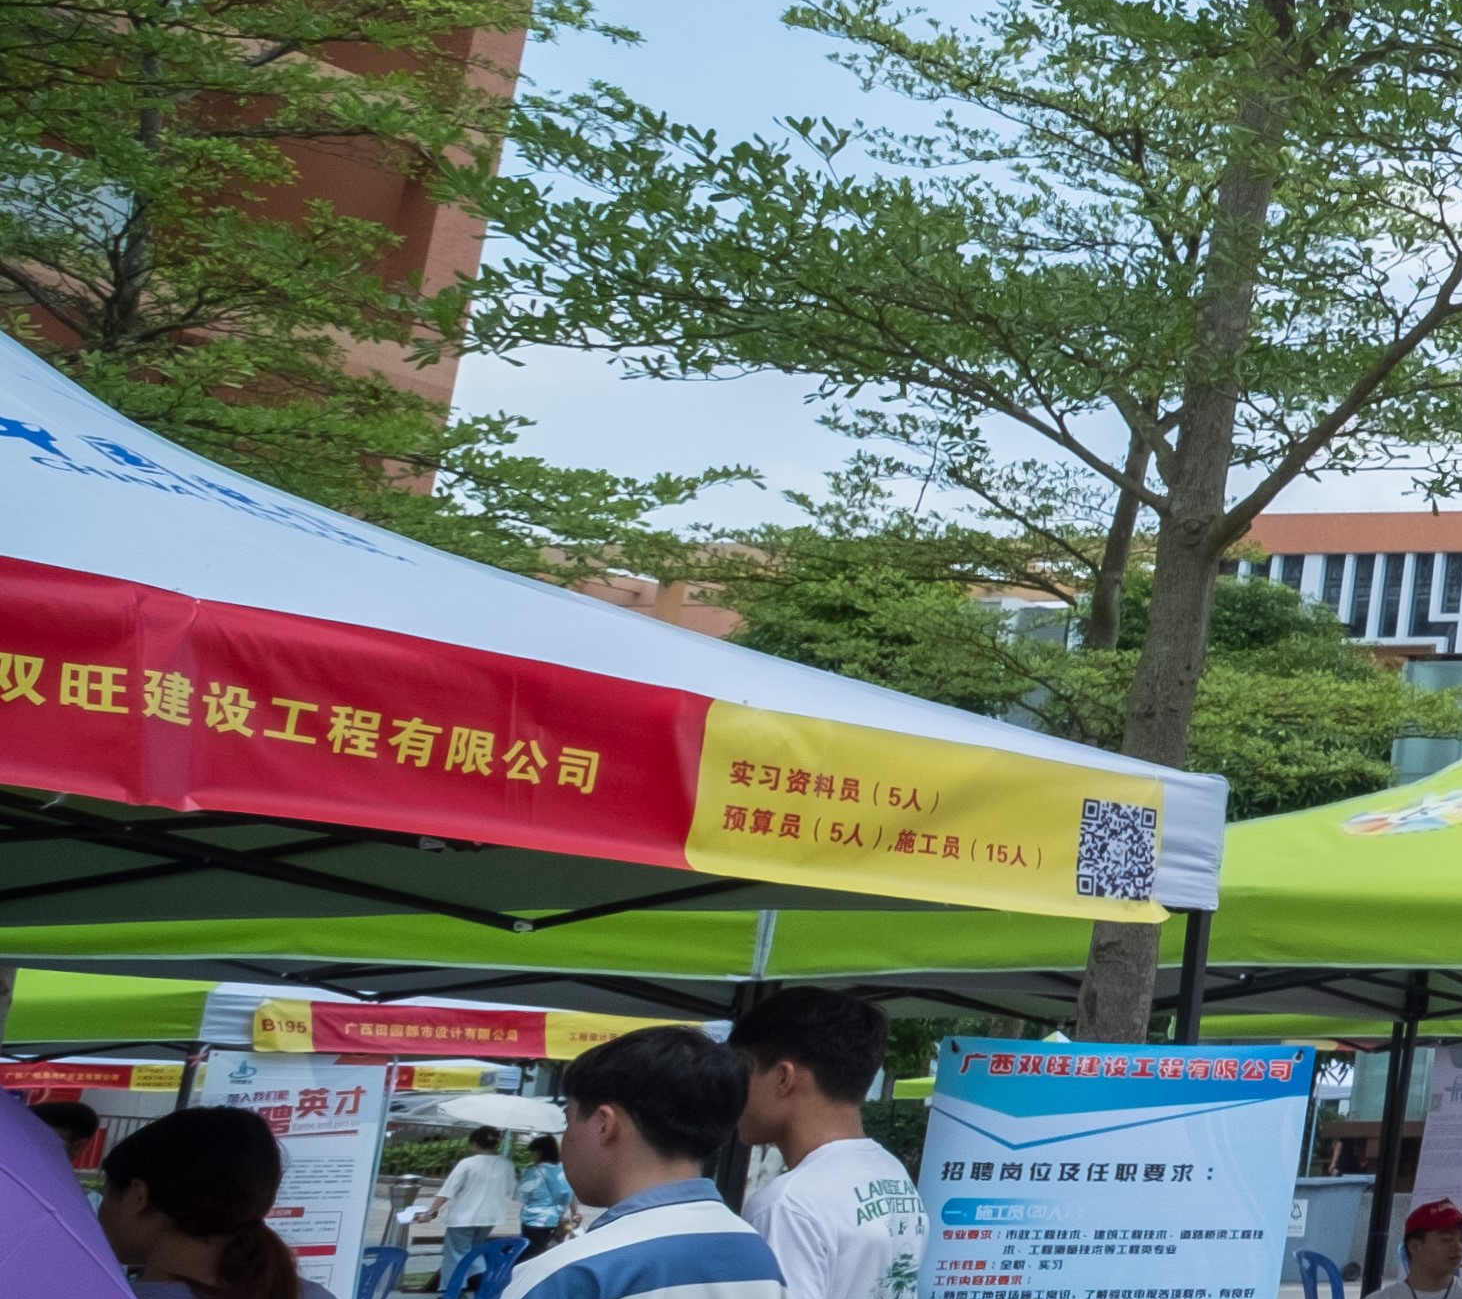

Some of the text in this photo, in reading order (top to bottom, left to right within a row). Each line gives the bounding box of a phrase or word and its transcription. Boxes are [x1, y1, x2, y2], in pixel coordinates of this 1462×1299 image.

[0, 651, 600, 794] 双旺建设工程有限公司
[261, 1018, 307, 1034] B195
[960, 1052, 1293, 1082] 广西双旺建设工程有限公司
